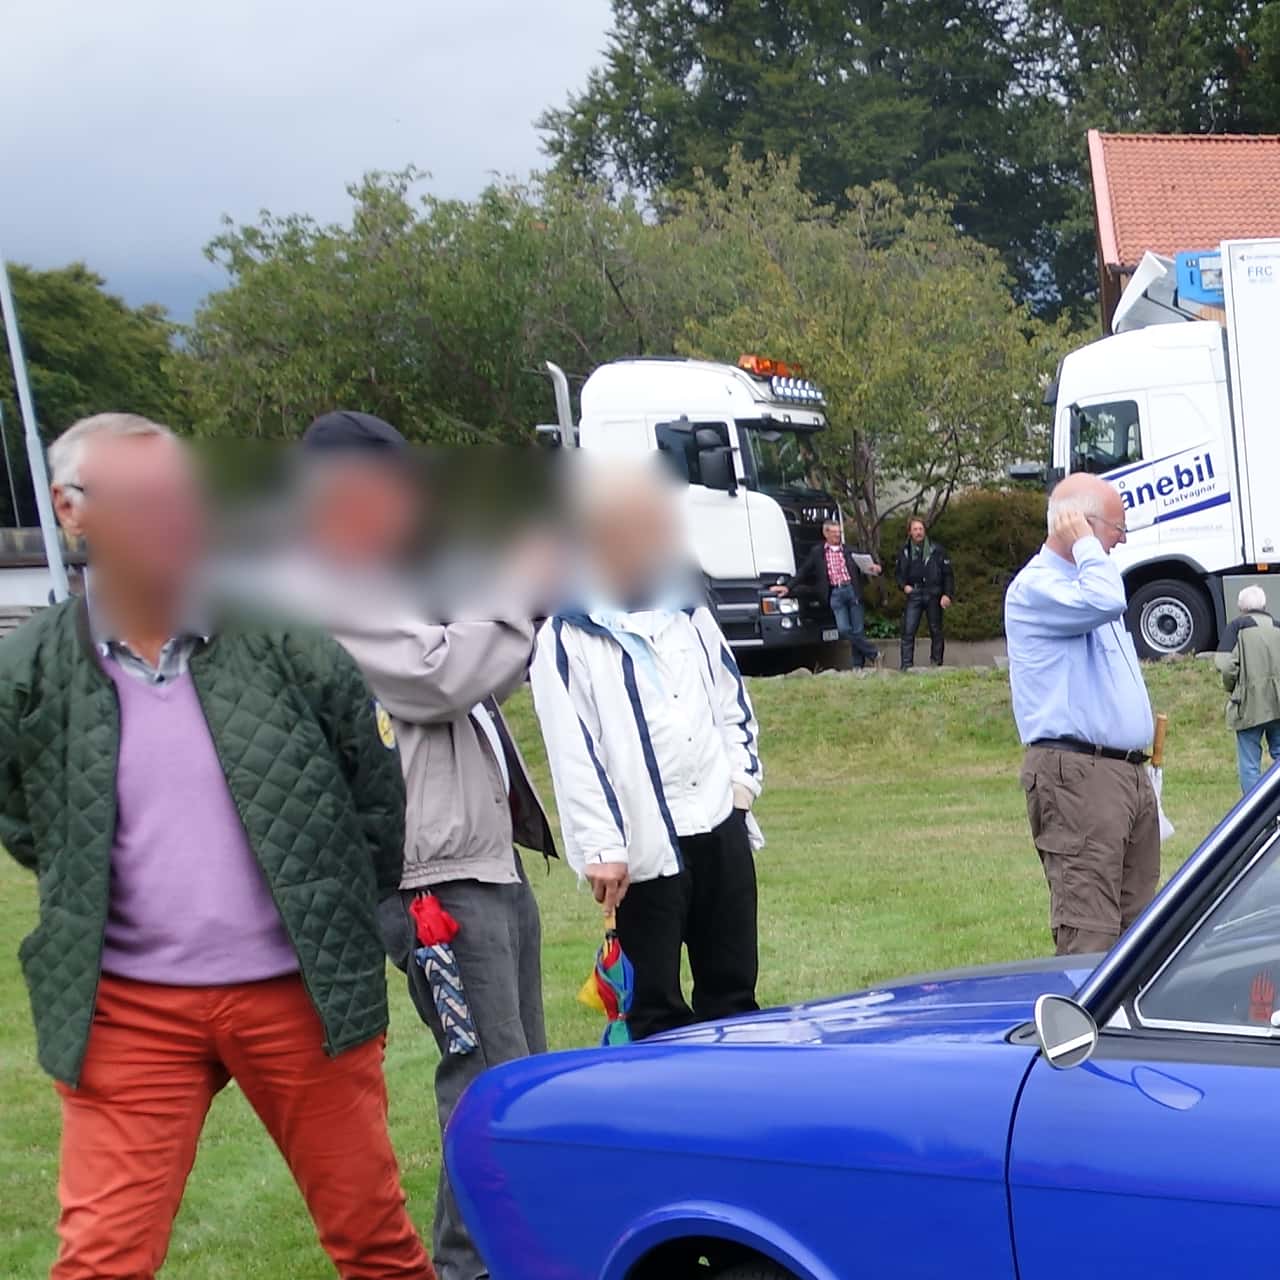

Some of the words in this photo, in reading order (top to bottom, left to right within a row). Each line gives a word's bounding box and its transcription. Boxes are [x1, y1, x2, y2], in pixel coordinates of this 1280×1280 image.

[1247, 266, 1273, 277] FRC
[1119, 452, 1215, 511] ånebil
[1162, 483, 1216, 507] Lastvagnar
